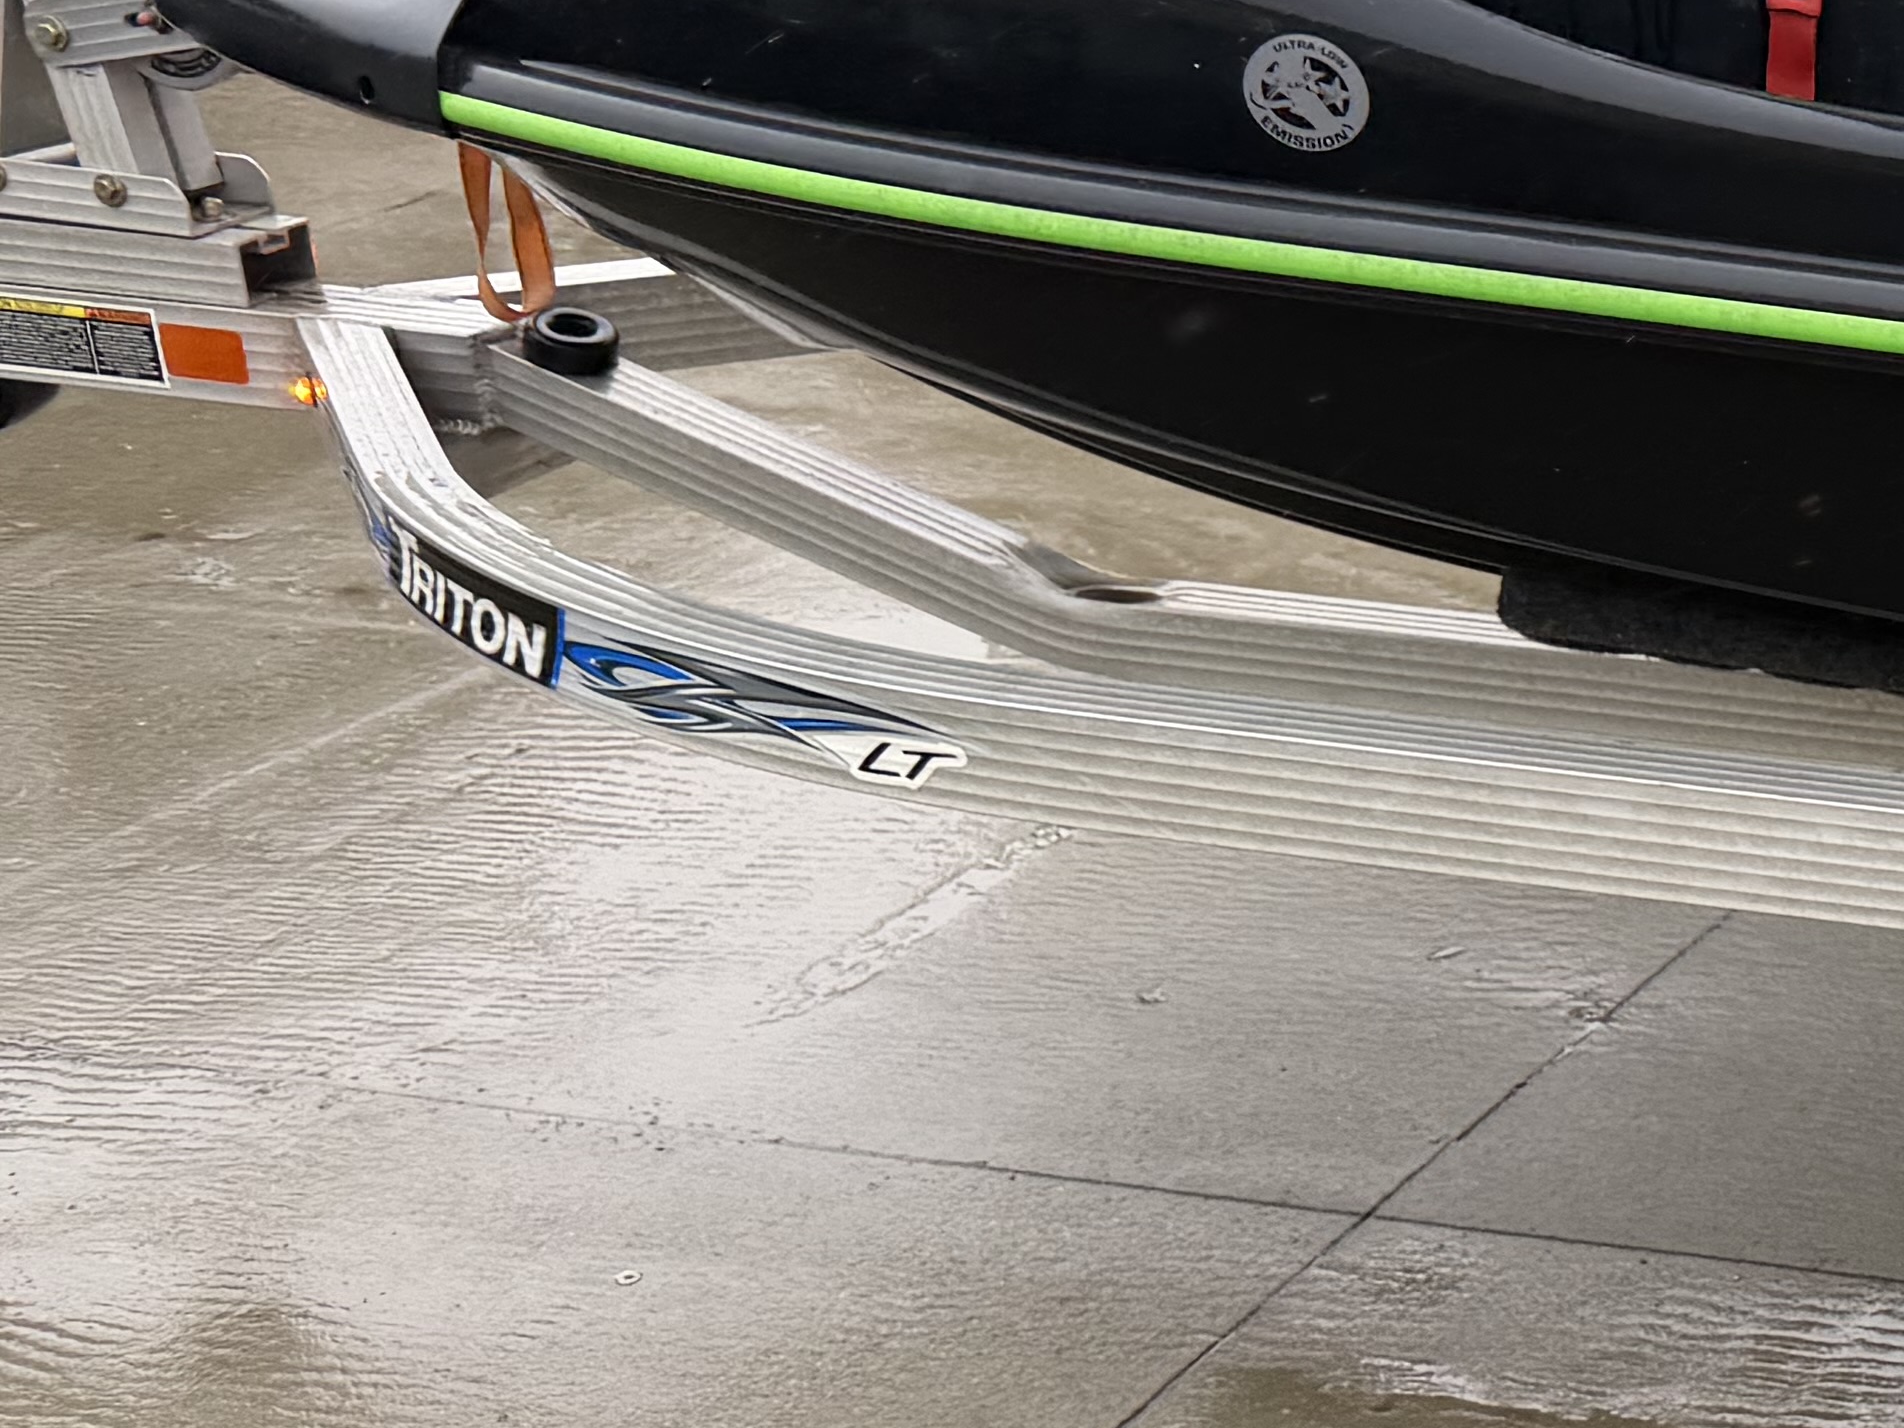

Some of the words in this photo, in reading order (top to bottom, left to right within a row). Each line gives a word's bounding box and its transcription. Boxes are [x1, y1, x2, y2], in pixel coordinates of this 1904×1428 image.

[1260, 115, 1349, 150] EMISSION
[388, 515, 548, 679] TRITON
[858, 742, 958, 781] LT
